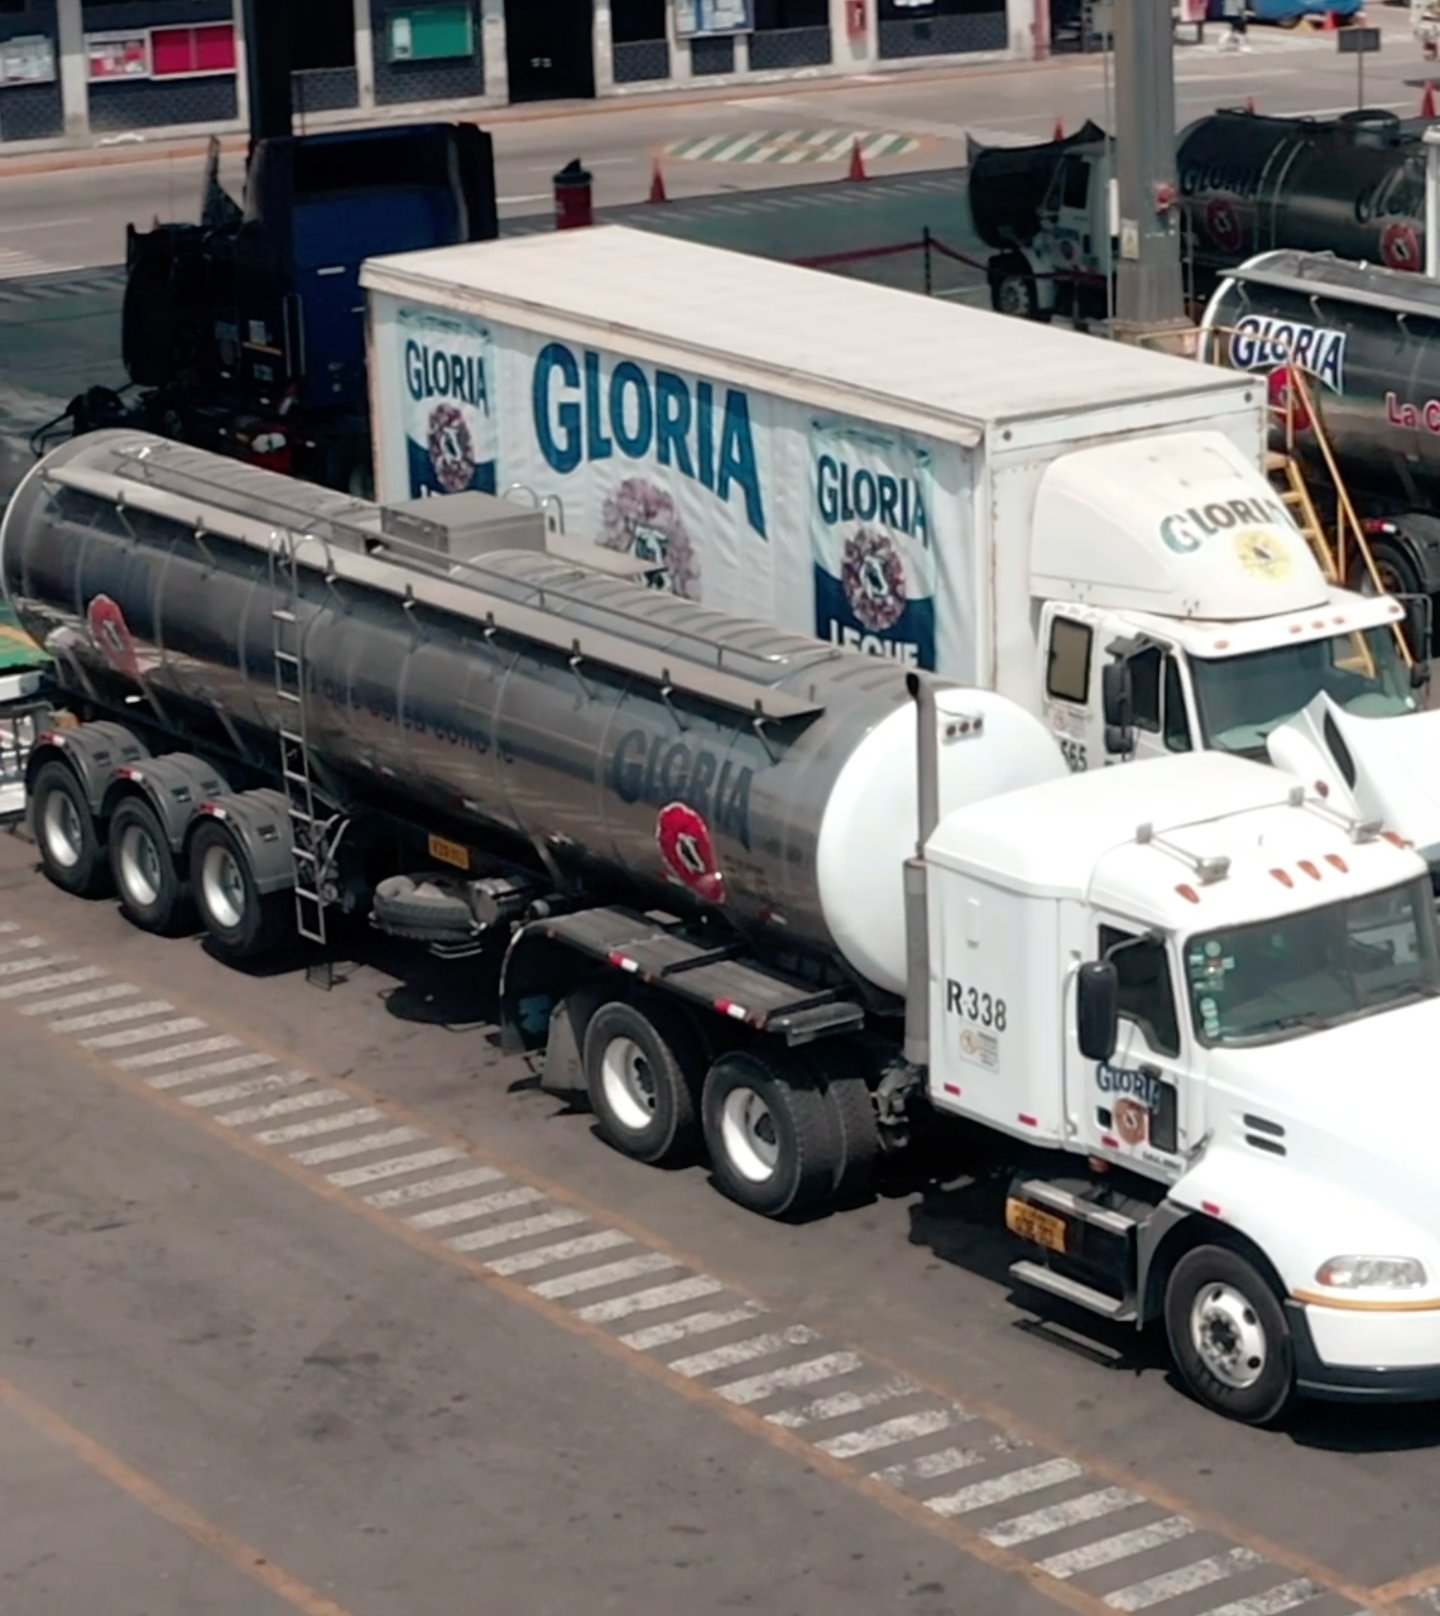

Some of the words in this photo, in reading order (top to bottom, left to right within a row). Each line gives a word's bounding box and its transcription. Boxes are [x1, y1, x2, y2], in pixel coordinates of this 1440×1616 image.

[405, 339, 489, 418] GLORIA
[1231, 317, 1343, 390] GLORIA
[533, 342, 769, 542] GLORIA
[1385, 392, 1417, 429] La
[818, 454, 930, 549] GLORIA
[612, 729, 753, 853] GLORIA
